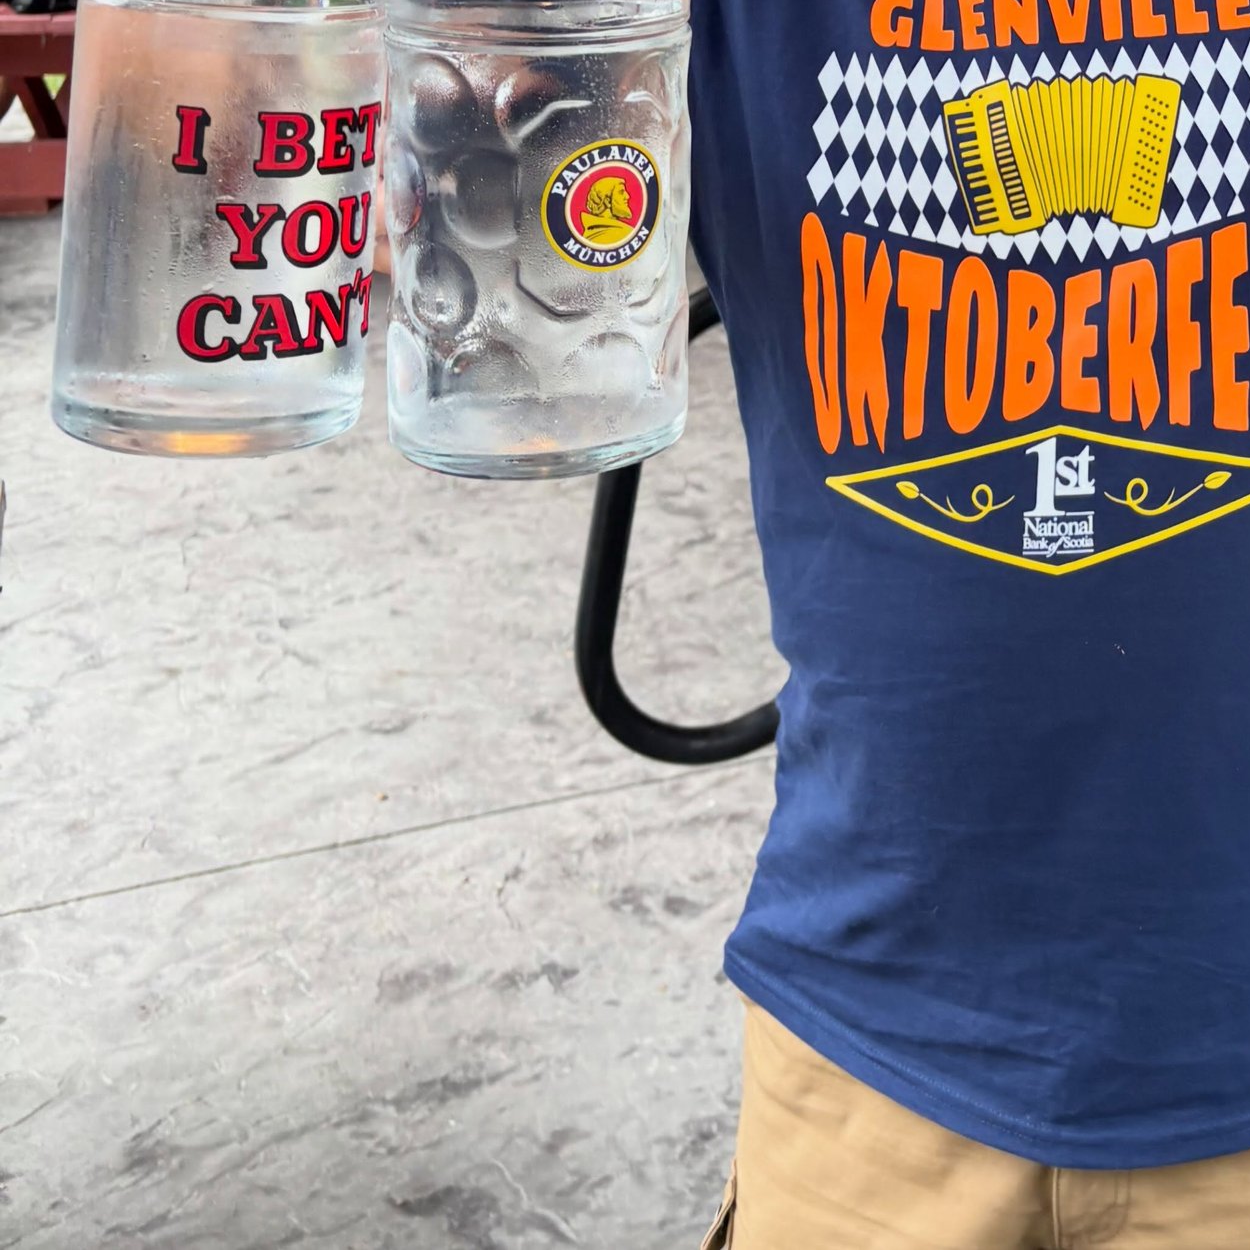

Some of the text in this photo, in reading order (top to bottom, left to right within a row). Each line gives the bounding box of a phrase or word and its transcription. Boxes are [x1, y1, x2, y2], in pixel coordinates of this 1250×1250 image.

[172, 101, 382, 178] I BET
[551, 145, 655, 198] PAULANER
[215, 190, 372, 270] YOU
[563, 225, 650, 264] MÜNCHEN
[176, 266, 374, 363] CAN'T
[1023, 436, 1096, 517] 1st
[1022, 513, 1095, 537] National
[1022, 535, 1095, 558] Bank of Scotia
